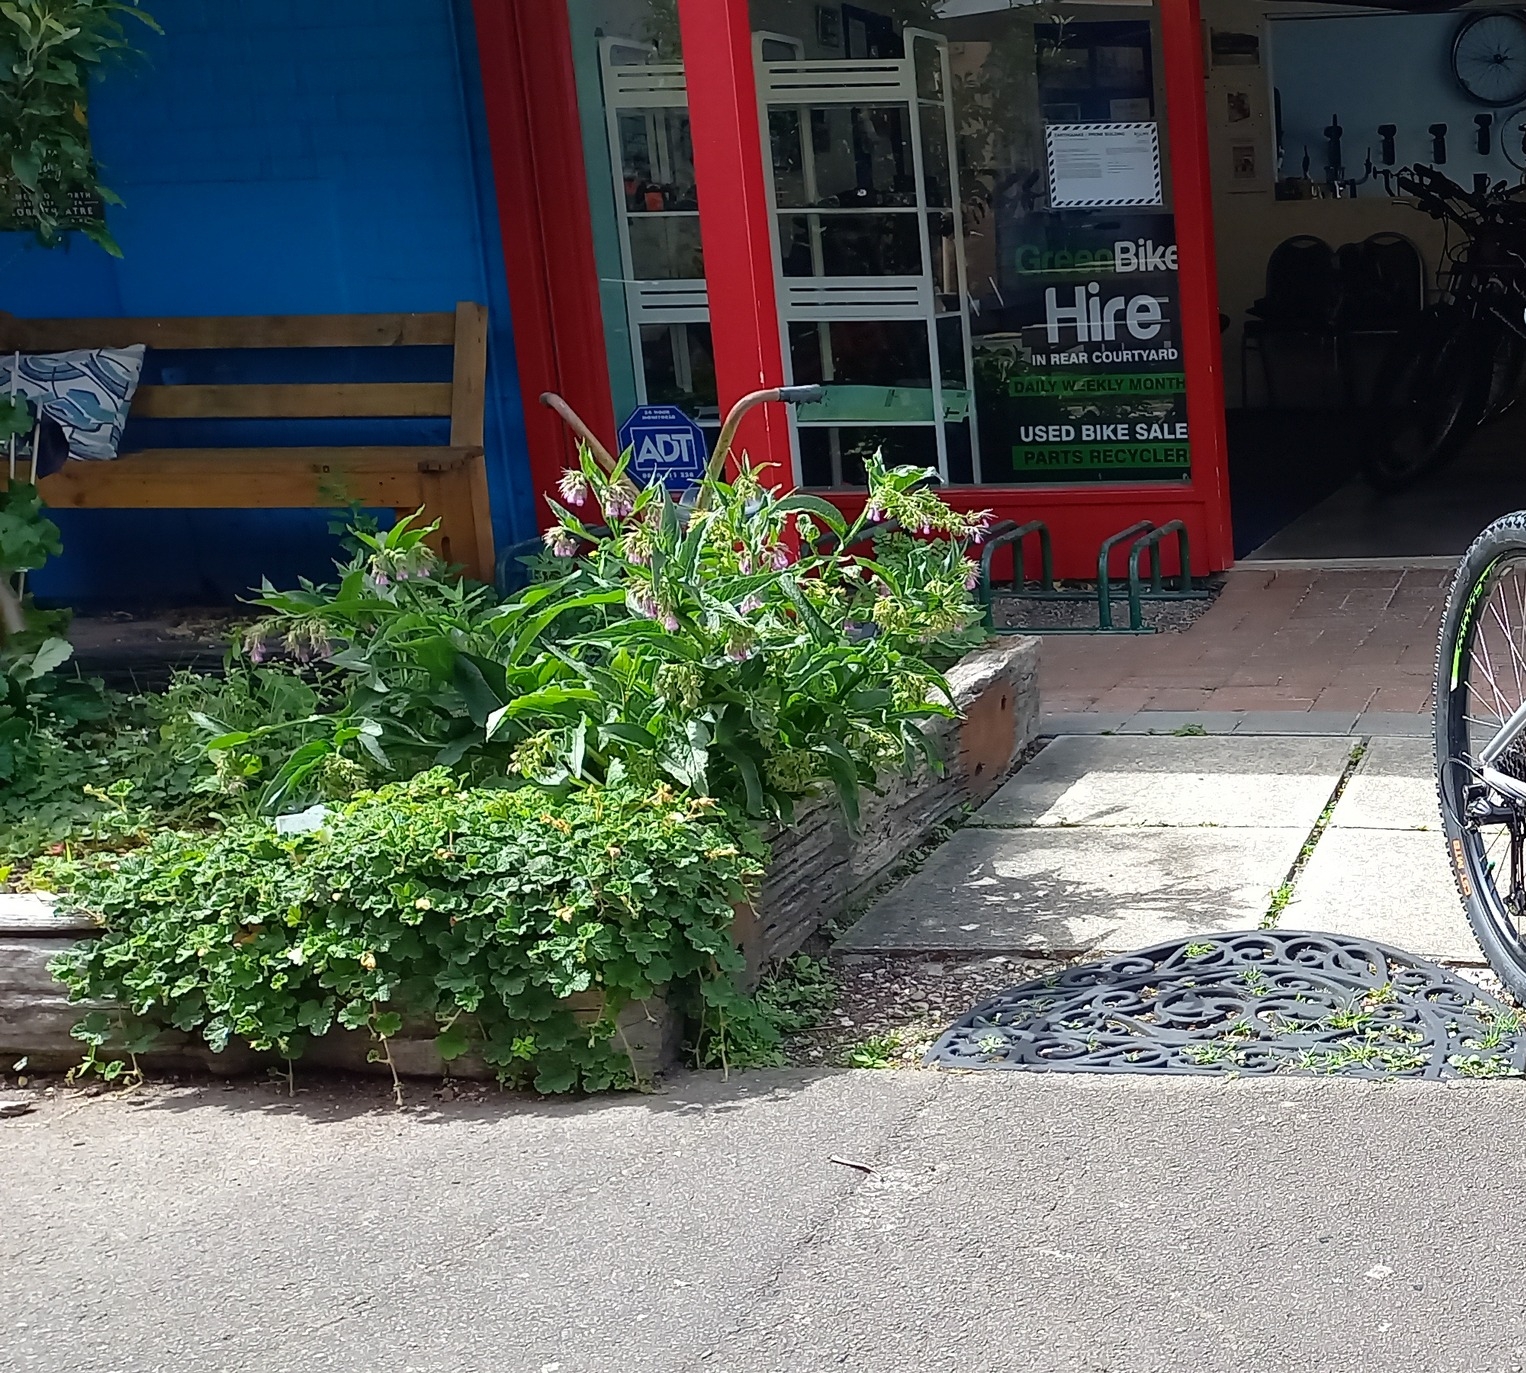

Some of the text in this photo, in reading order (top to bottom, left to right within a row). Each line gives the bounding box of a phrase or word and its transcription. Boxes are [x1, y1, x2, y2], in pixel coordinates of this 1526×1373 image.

[1045, 281, 1162, 344] Hire
[1032, 348, 1179, 366] IN REAR COURTYARD
[1014, 379, 1057, 393] DAILY
[1062, 378, 1127, 392] WEEKLY
[1020, 422, 1188, 442] USED BIKE SALE
[637, 433, 693, 463] ADT
[1024, 449, 1083, 465] PARTS
